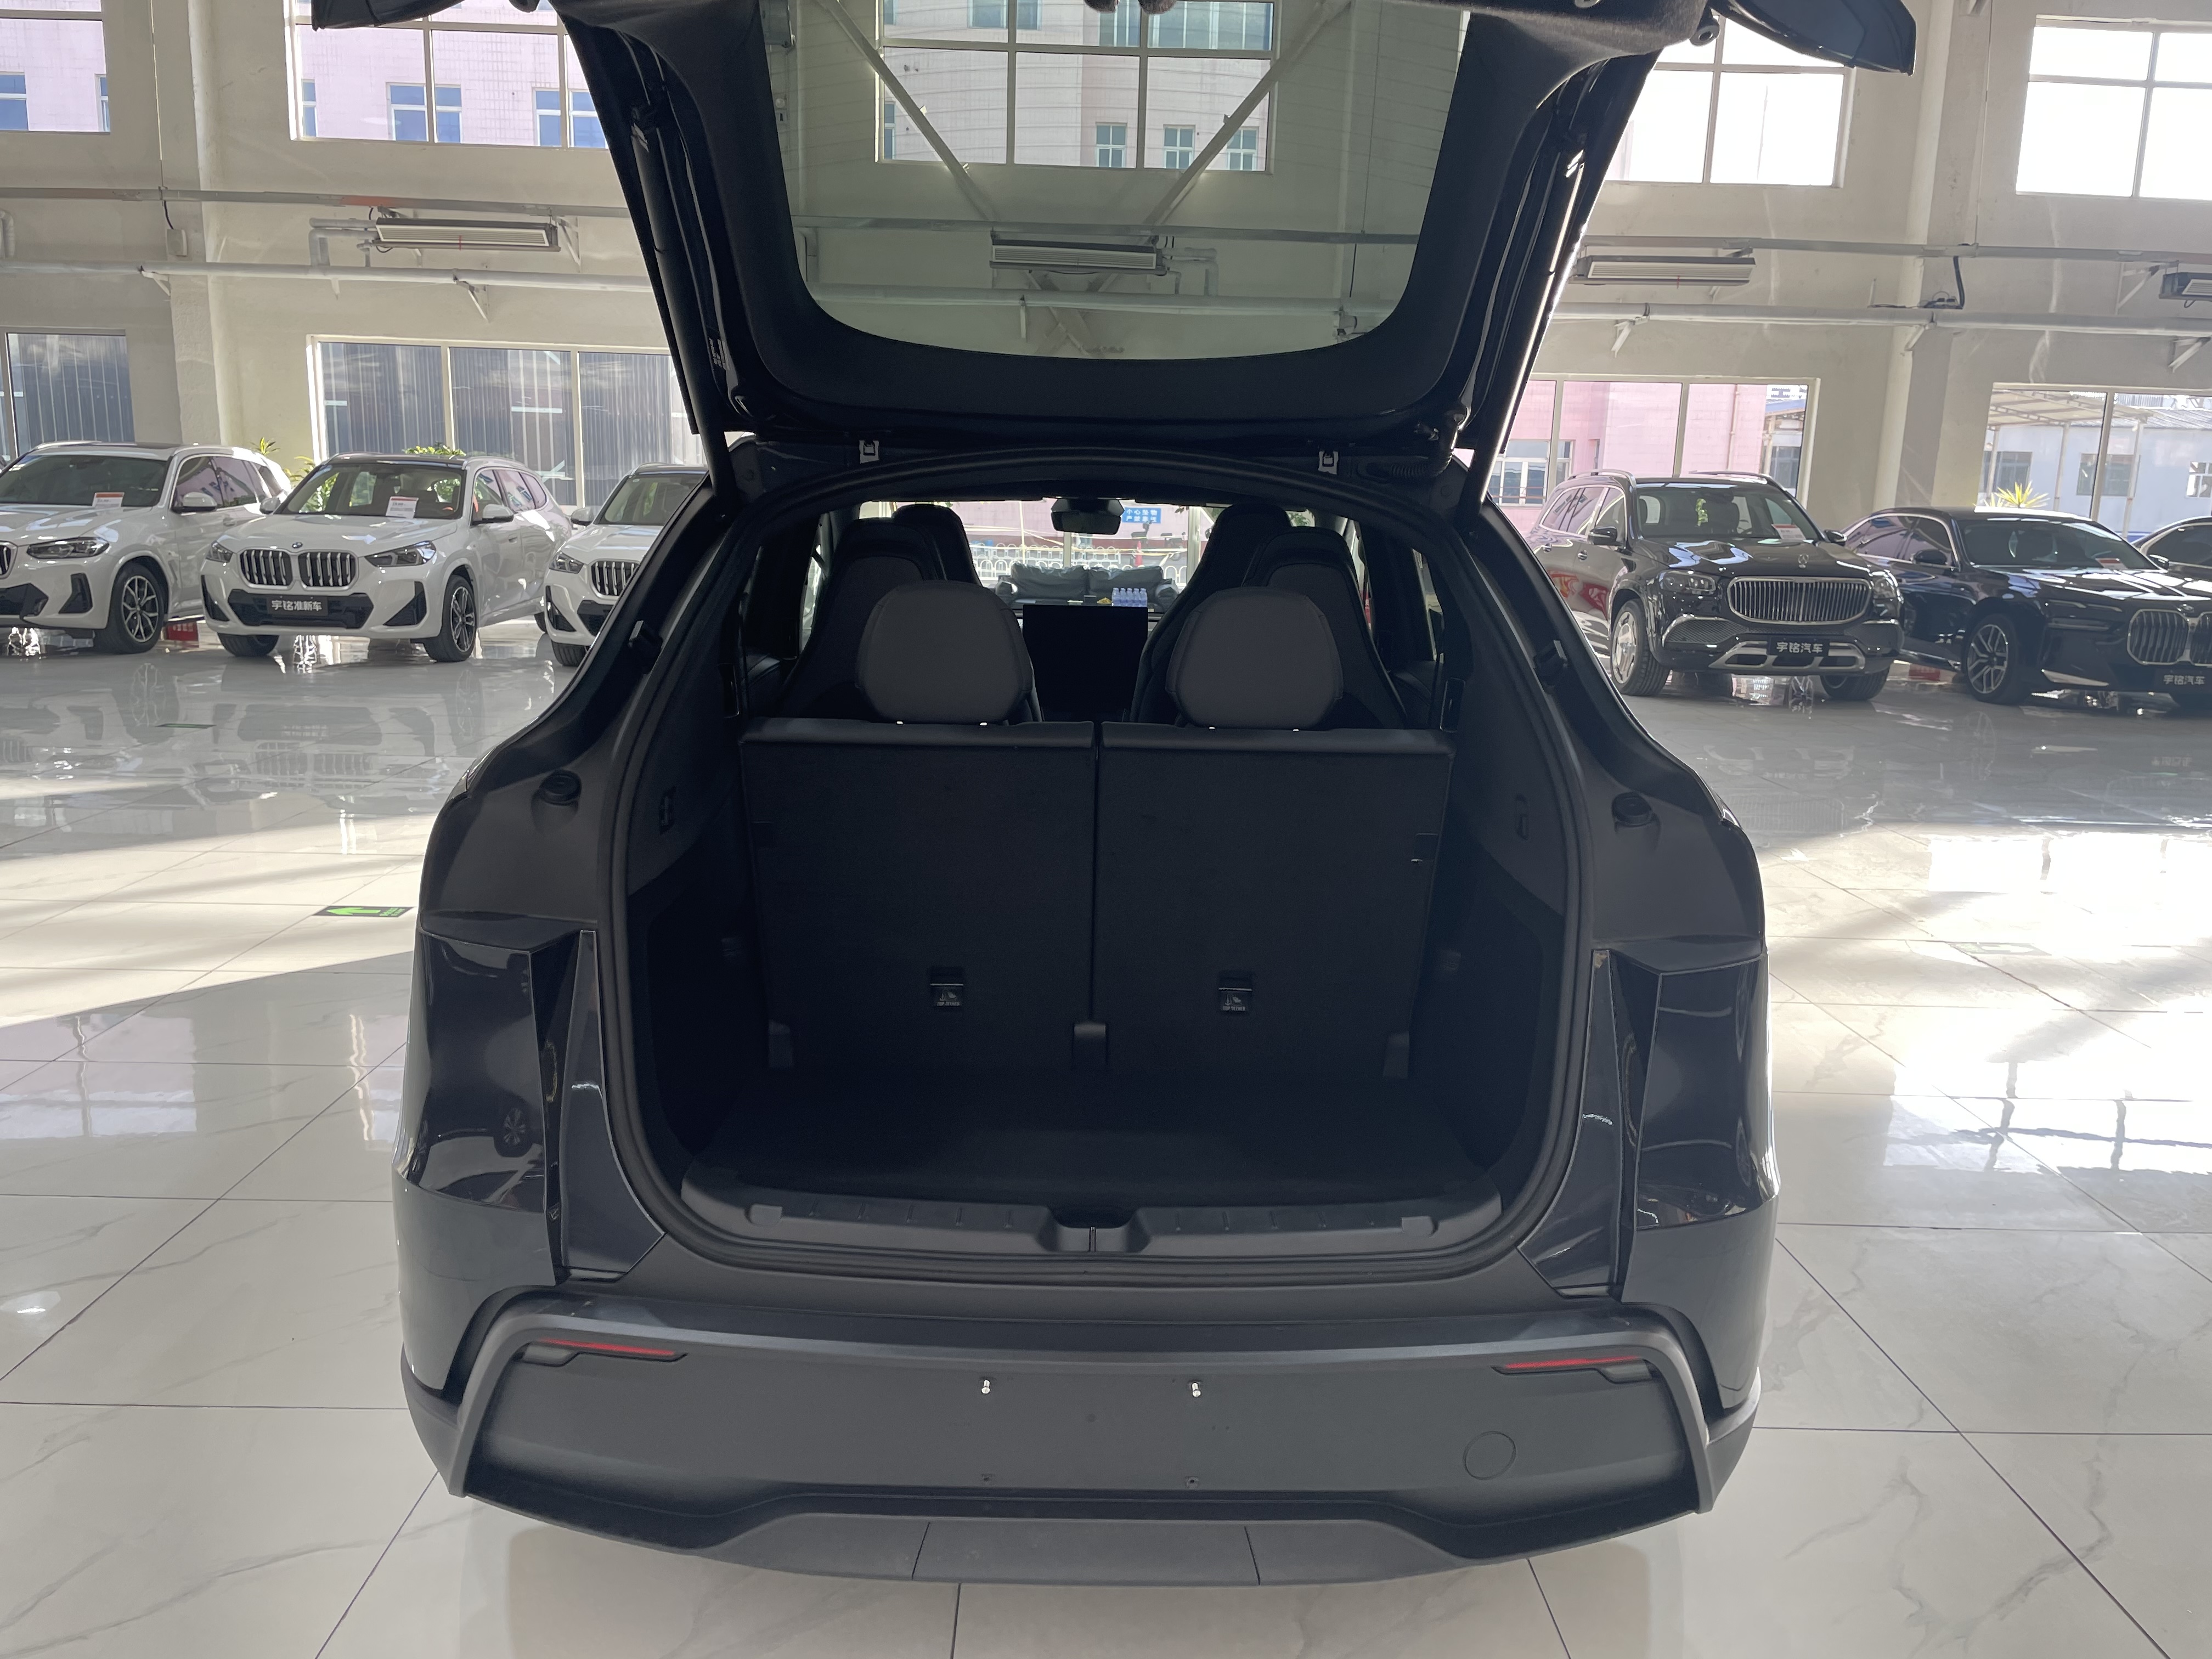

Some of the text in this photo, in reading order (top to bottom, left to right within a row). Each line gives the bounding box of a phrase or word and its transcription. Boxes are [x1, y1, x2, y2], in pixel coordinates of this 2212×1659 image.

[272, 600, 322, 611] 宇铭准新车
[1776, 641, 1823, 653] 宇铭汽车
[2163, 675, 2205, 685] 宇铭汽车
